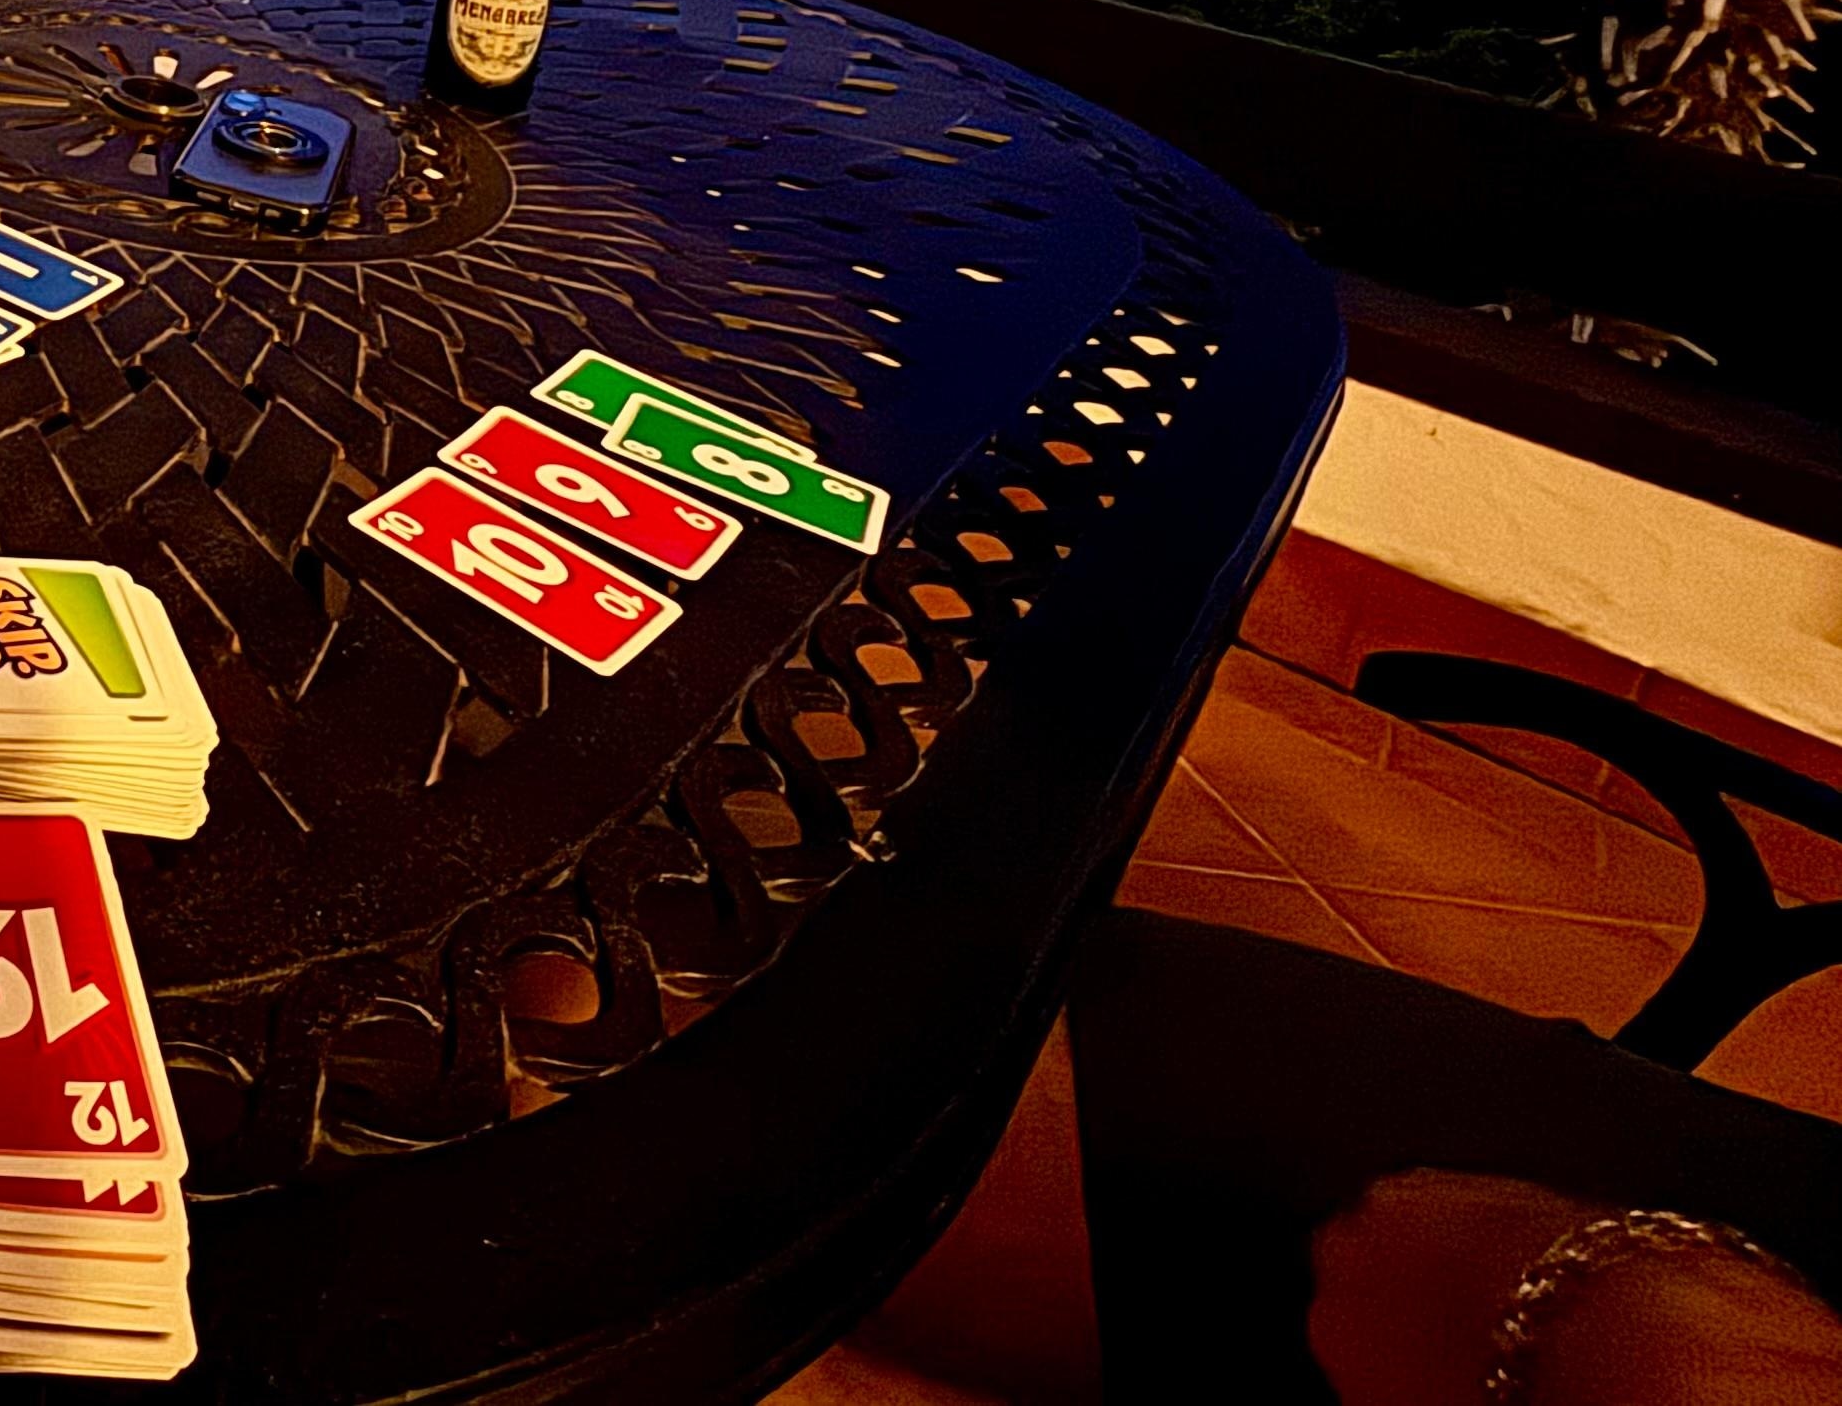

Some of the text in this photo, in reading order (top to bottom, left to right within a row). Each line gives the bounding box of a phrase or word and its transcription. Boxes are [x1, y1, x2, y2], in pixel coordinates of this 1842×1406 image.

[70, 270, 99, 286] 1
[556, 389, 595, 411] 8
[460, 452, 498, 475] 9
[622, 439, 663, 461] 8
[691, 443, 790, 496] 8
[534, 463, 631, 519] 9
[821, 478, 866, 503] 8
[377, 510, 425, 542] 10
[673, 505, 717, 532] 9
[451, 523, 569, 605] 10
[593, 584, 646, 621] 10
[64, 1080, 151, 1147] 12
